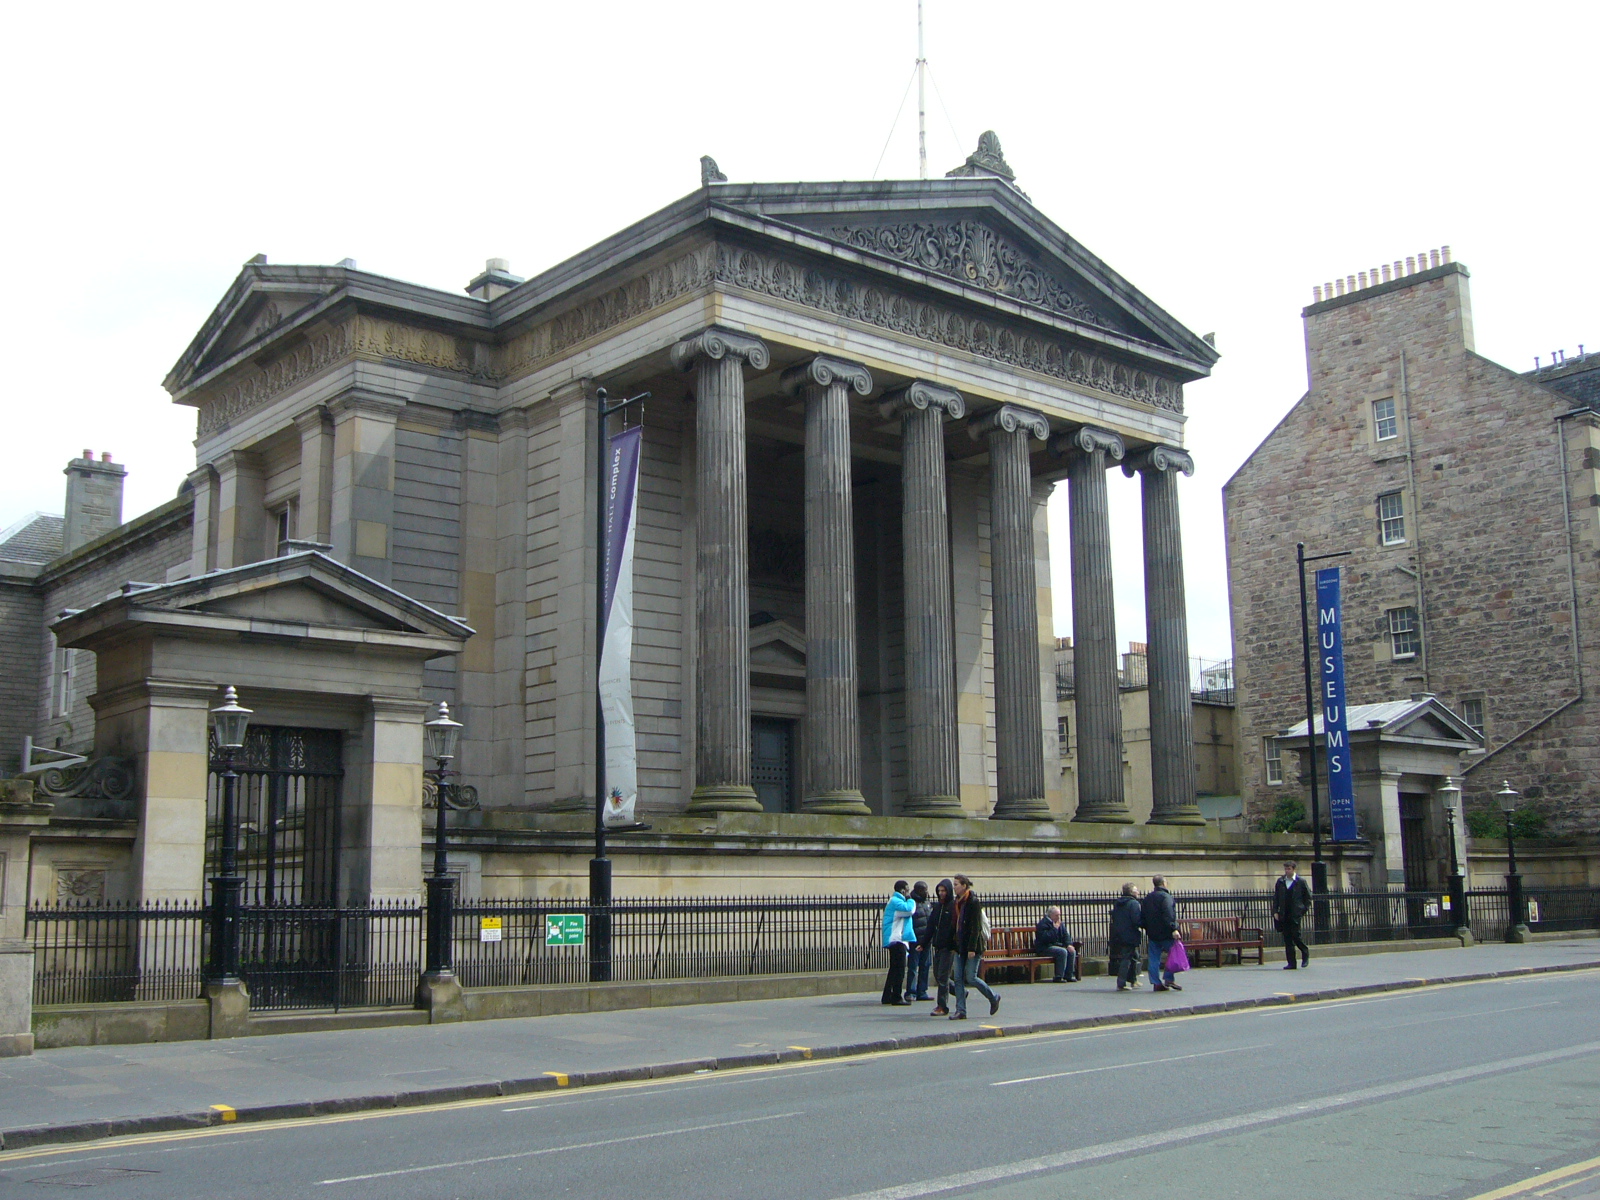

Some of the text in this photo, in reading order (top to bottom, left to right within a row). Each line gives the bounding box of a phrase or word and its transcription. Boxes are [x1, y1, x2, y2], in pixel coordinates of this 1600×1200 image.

[610, 447, 621, 500] complex
[1320, 607, 1343, 773] MUSEUMS
[1331, 798, 1350, 806] OPEN
